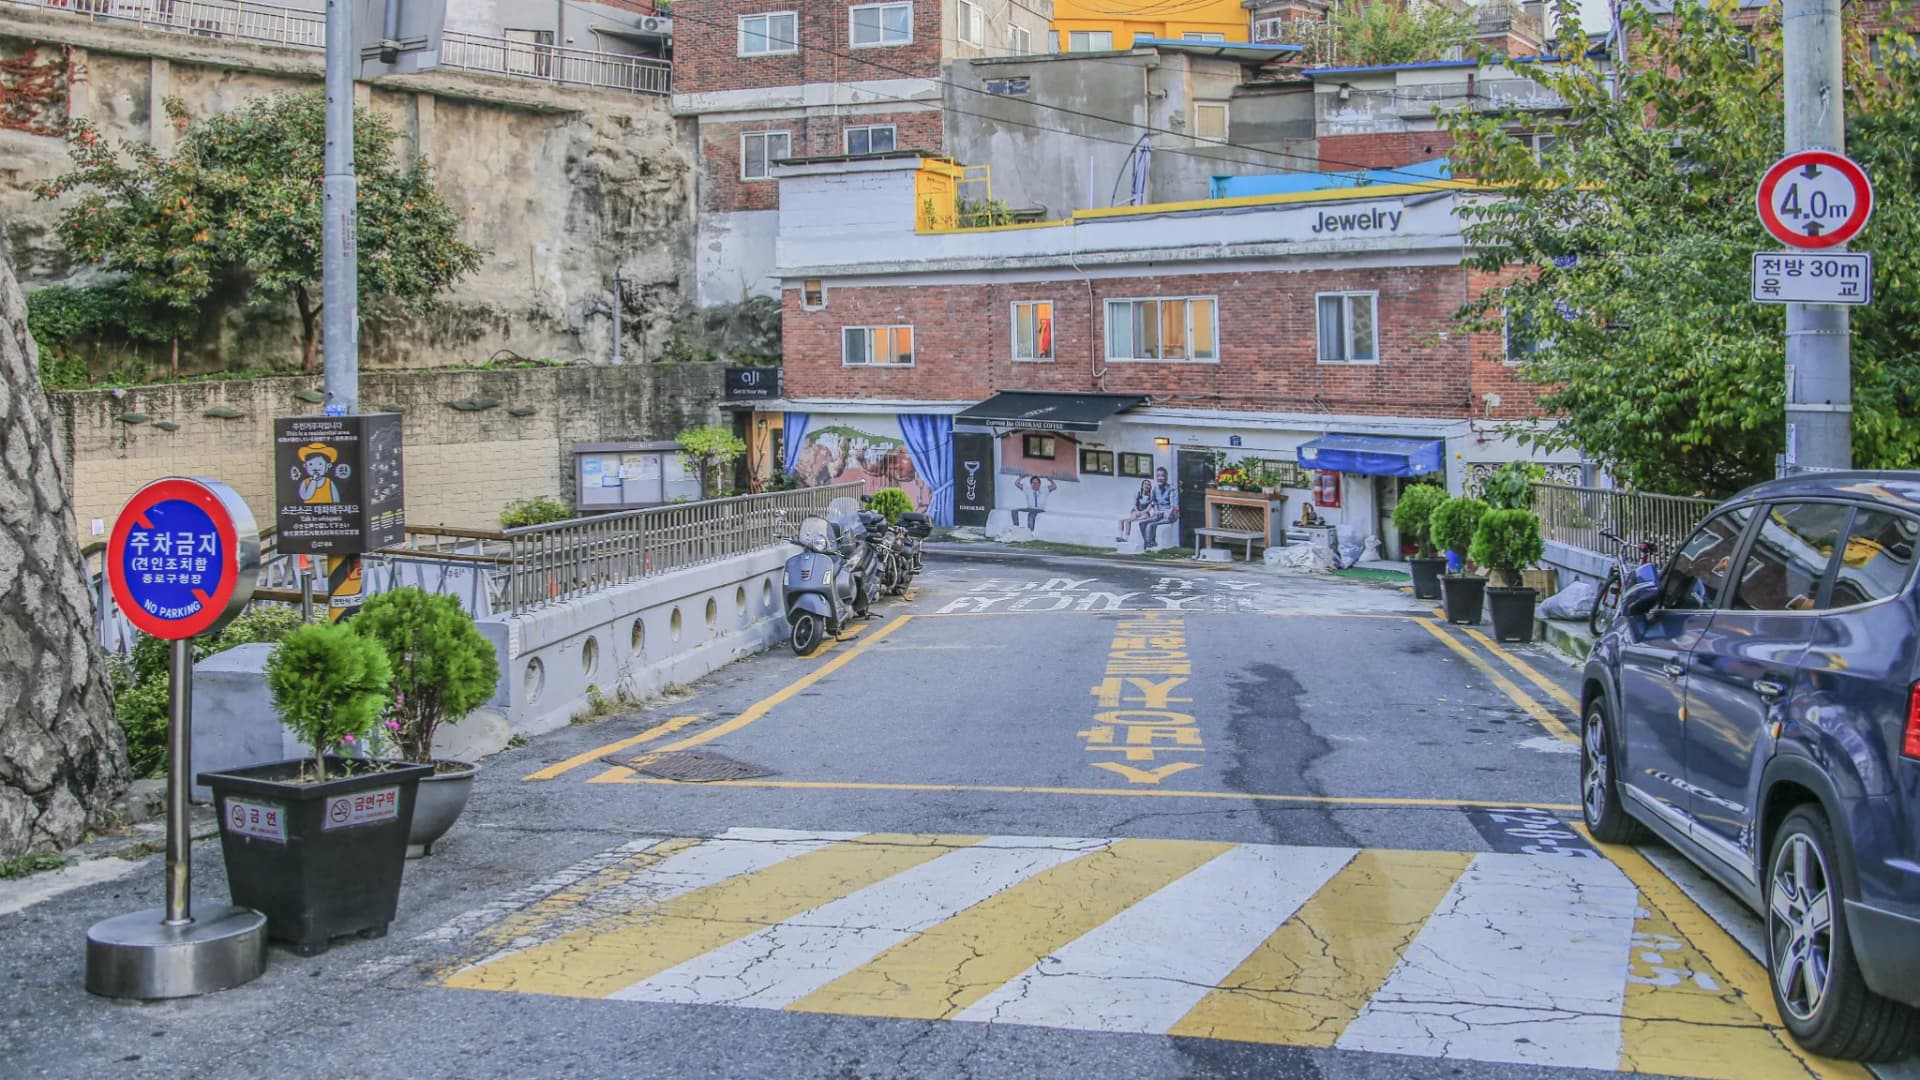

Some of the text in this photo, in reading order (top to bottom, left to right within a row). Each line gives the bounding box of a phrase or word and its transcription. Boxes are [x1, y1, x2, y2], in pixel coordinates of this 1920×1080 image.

[1780, 183, 1848, 219] 4.0m
[1312, 207, 1402, 233] Jewelry
[1761, 259, 1860, 278] 전방 30m
[130, 531, 217, 556] 주차금지
[142, 573, 203, 585] 종로구청장
[143, 599, 201, 618] NO PARKING
[354, 791, 396, 812] 금연구역
